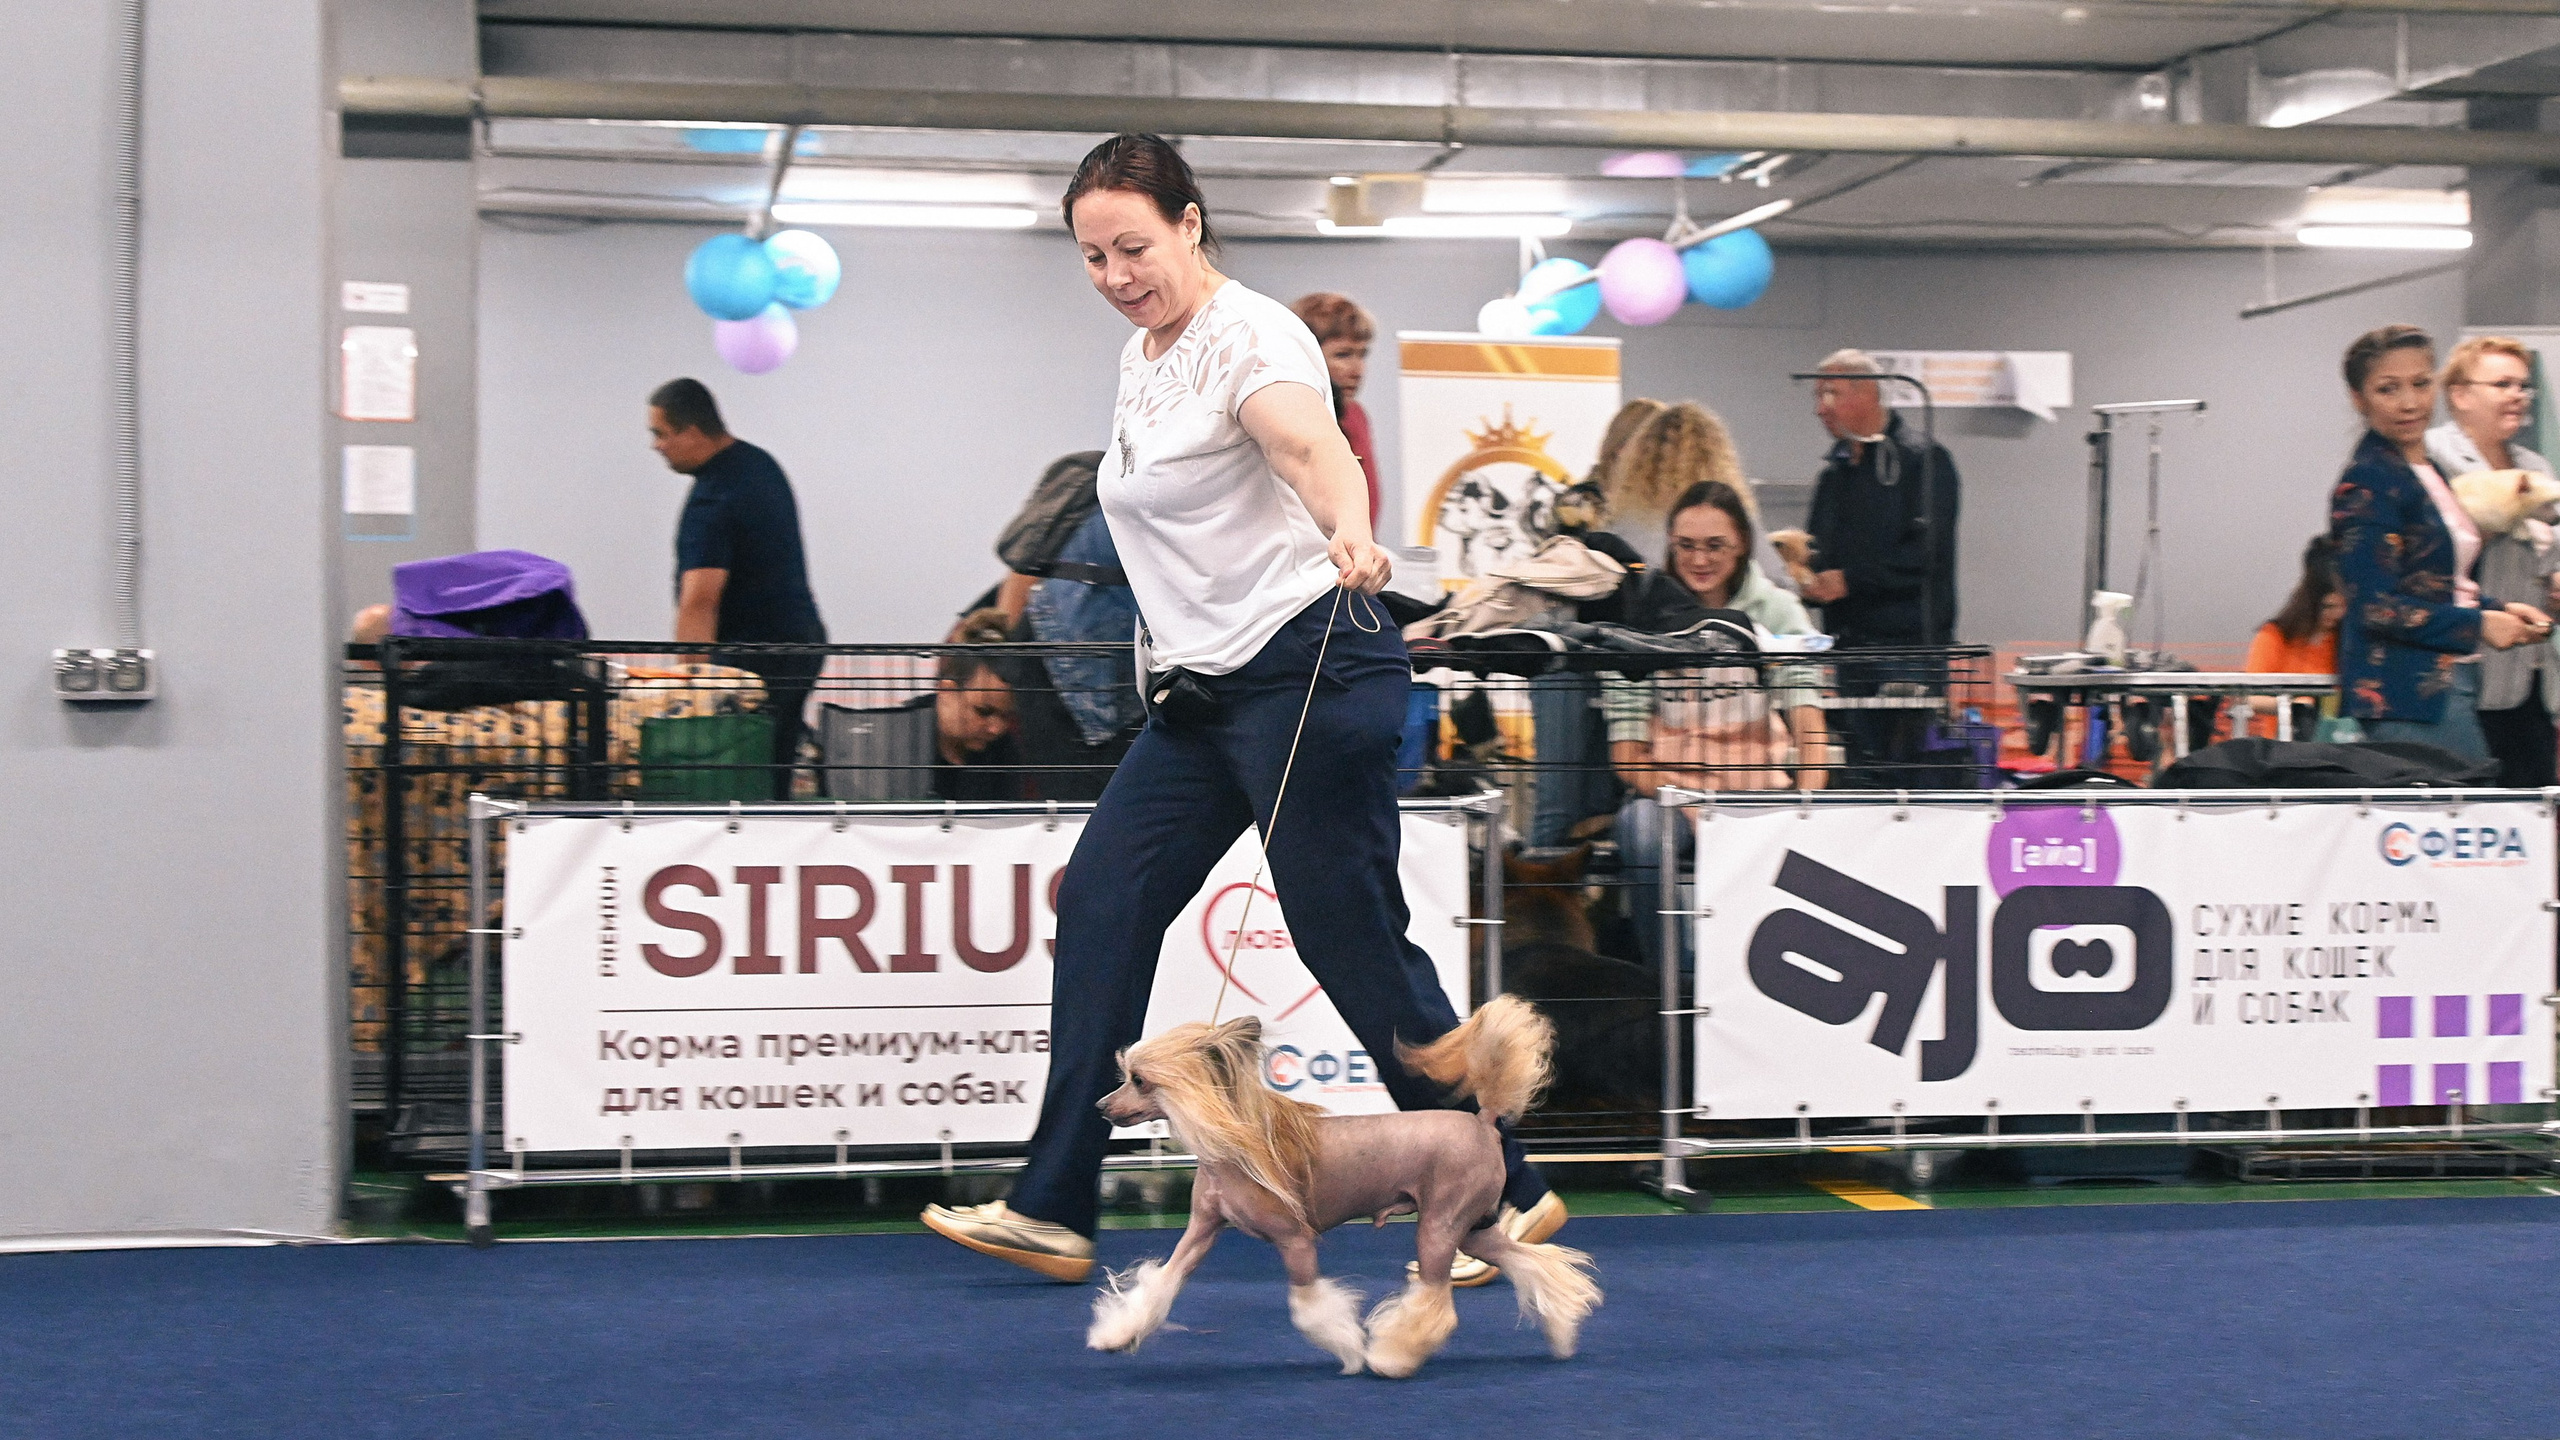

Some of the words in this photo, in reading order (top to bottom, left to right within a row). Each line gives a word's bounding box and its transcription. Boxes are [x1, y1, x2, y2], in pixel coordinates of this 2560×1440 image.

[2379, 822, 2526, 866] СФЕРА
[598, 866, 619, 977] PREMIUM
[2192, 901, 2302, 937] СУХИЕ
[2328, 898, 2441, 934] КОРМА
[1221, 930, 1295, 949] ЛЮБ
[2191, 948, 2260, 987] ДЛЯ
[2283, 945, 2396, 980] КОШЕК
[2192, 993, 2215, 1025] И
[2238, 991, 2351, 1023] СОБАК
[599, 1028, 739, 1067] Корма
[756, 1027, 1050, 1066] премиум-кла
[1263, 1044, 1384, 1092] СФЕ
[599, 1086, 683, 1117] для
[698, 1083, 845, 1110] кошек
[857, 1083, 886, 1107] и
[896, 1072, 1028, 1107] собак
